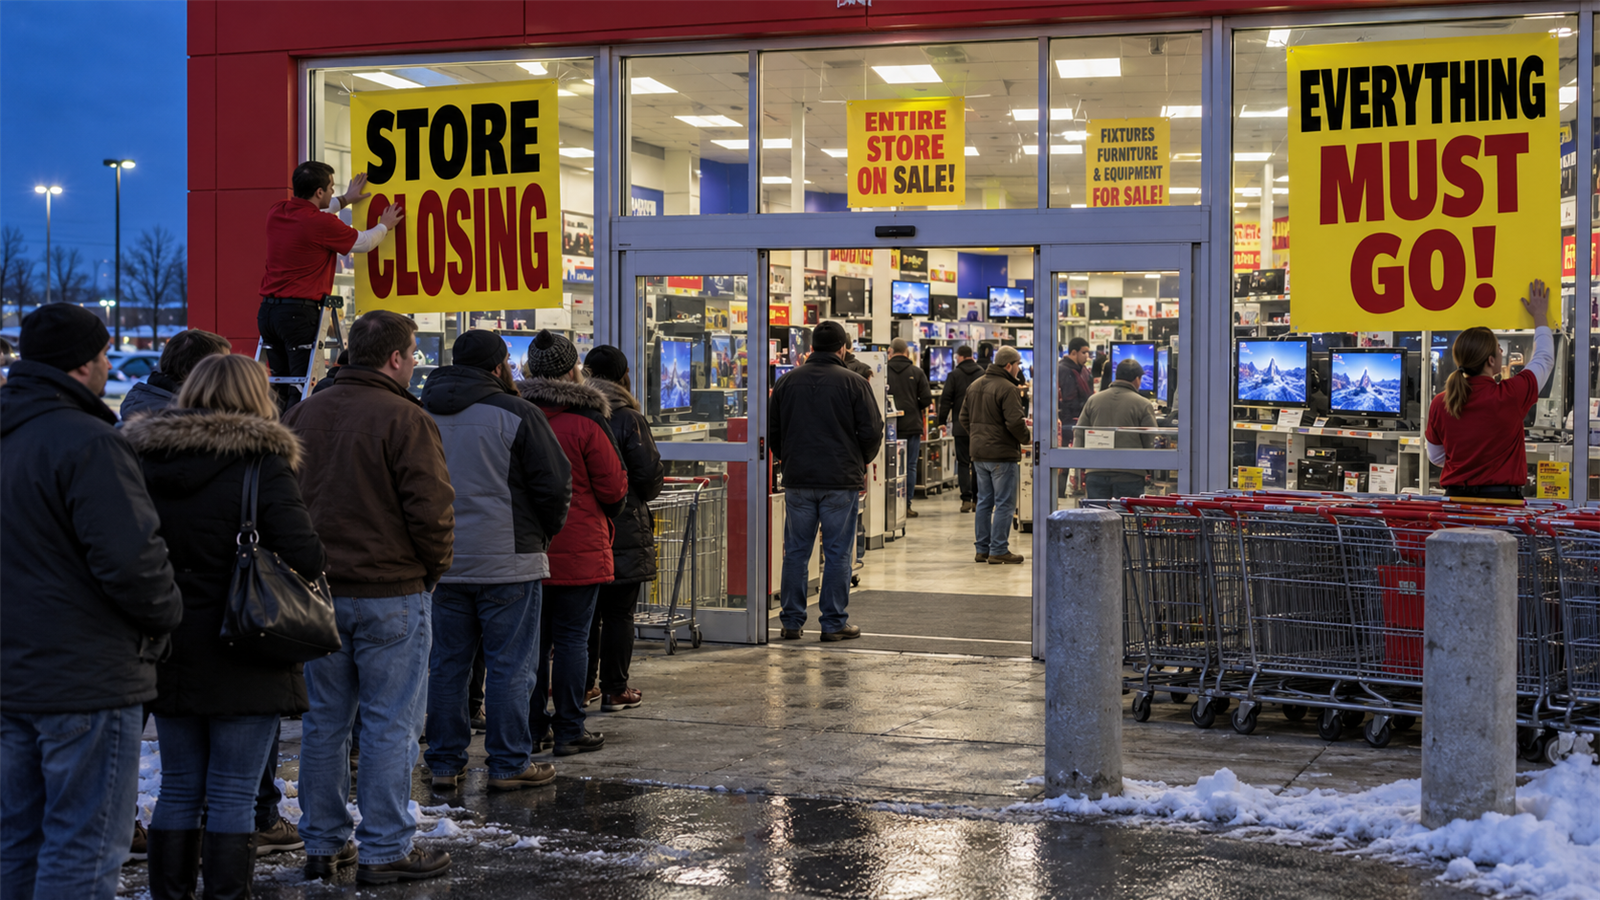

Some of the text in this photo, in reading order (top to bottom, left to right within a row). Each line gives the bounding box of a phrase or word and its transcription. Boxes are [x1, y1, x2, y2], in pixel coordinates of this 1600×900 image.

[1300, 55, 1546, 132] EVERYTHING
[865, 110, 946, 132] ENTIRE
[1101, 127, 1155, 143] FIXTURES
[366, 99, 540, 185] STORE
[867, 134, 944, 162] STORE
[1097, 146, 1158, 162] FURNITURE
[857, 164, 955, 195] ON SALE!
[1093, 165, 1163, 182] & EQUIPMENT
[1320, 132, 1529, 225] MUST
[1093, 185, 1163, 207] FOR SALE!
[366, 183, 549, 299] CLOSING
[1350, 225, 1497, 314] GO!
